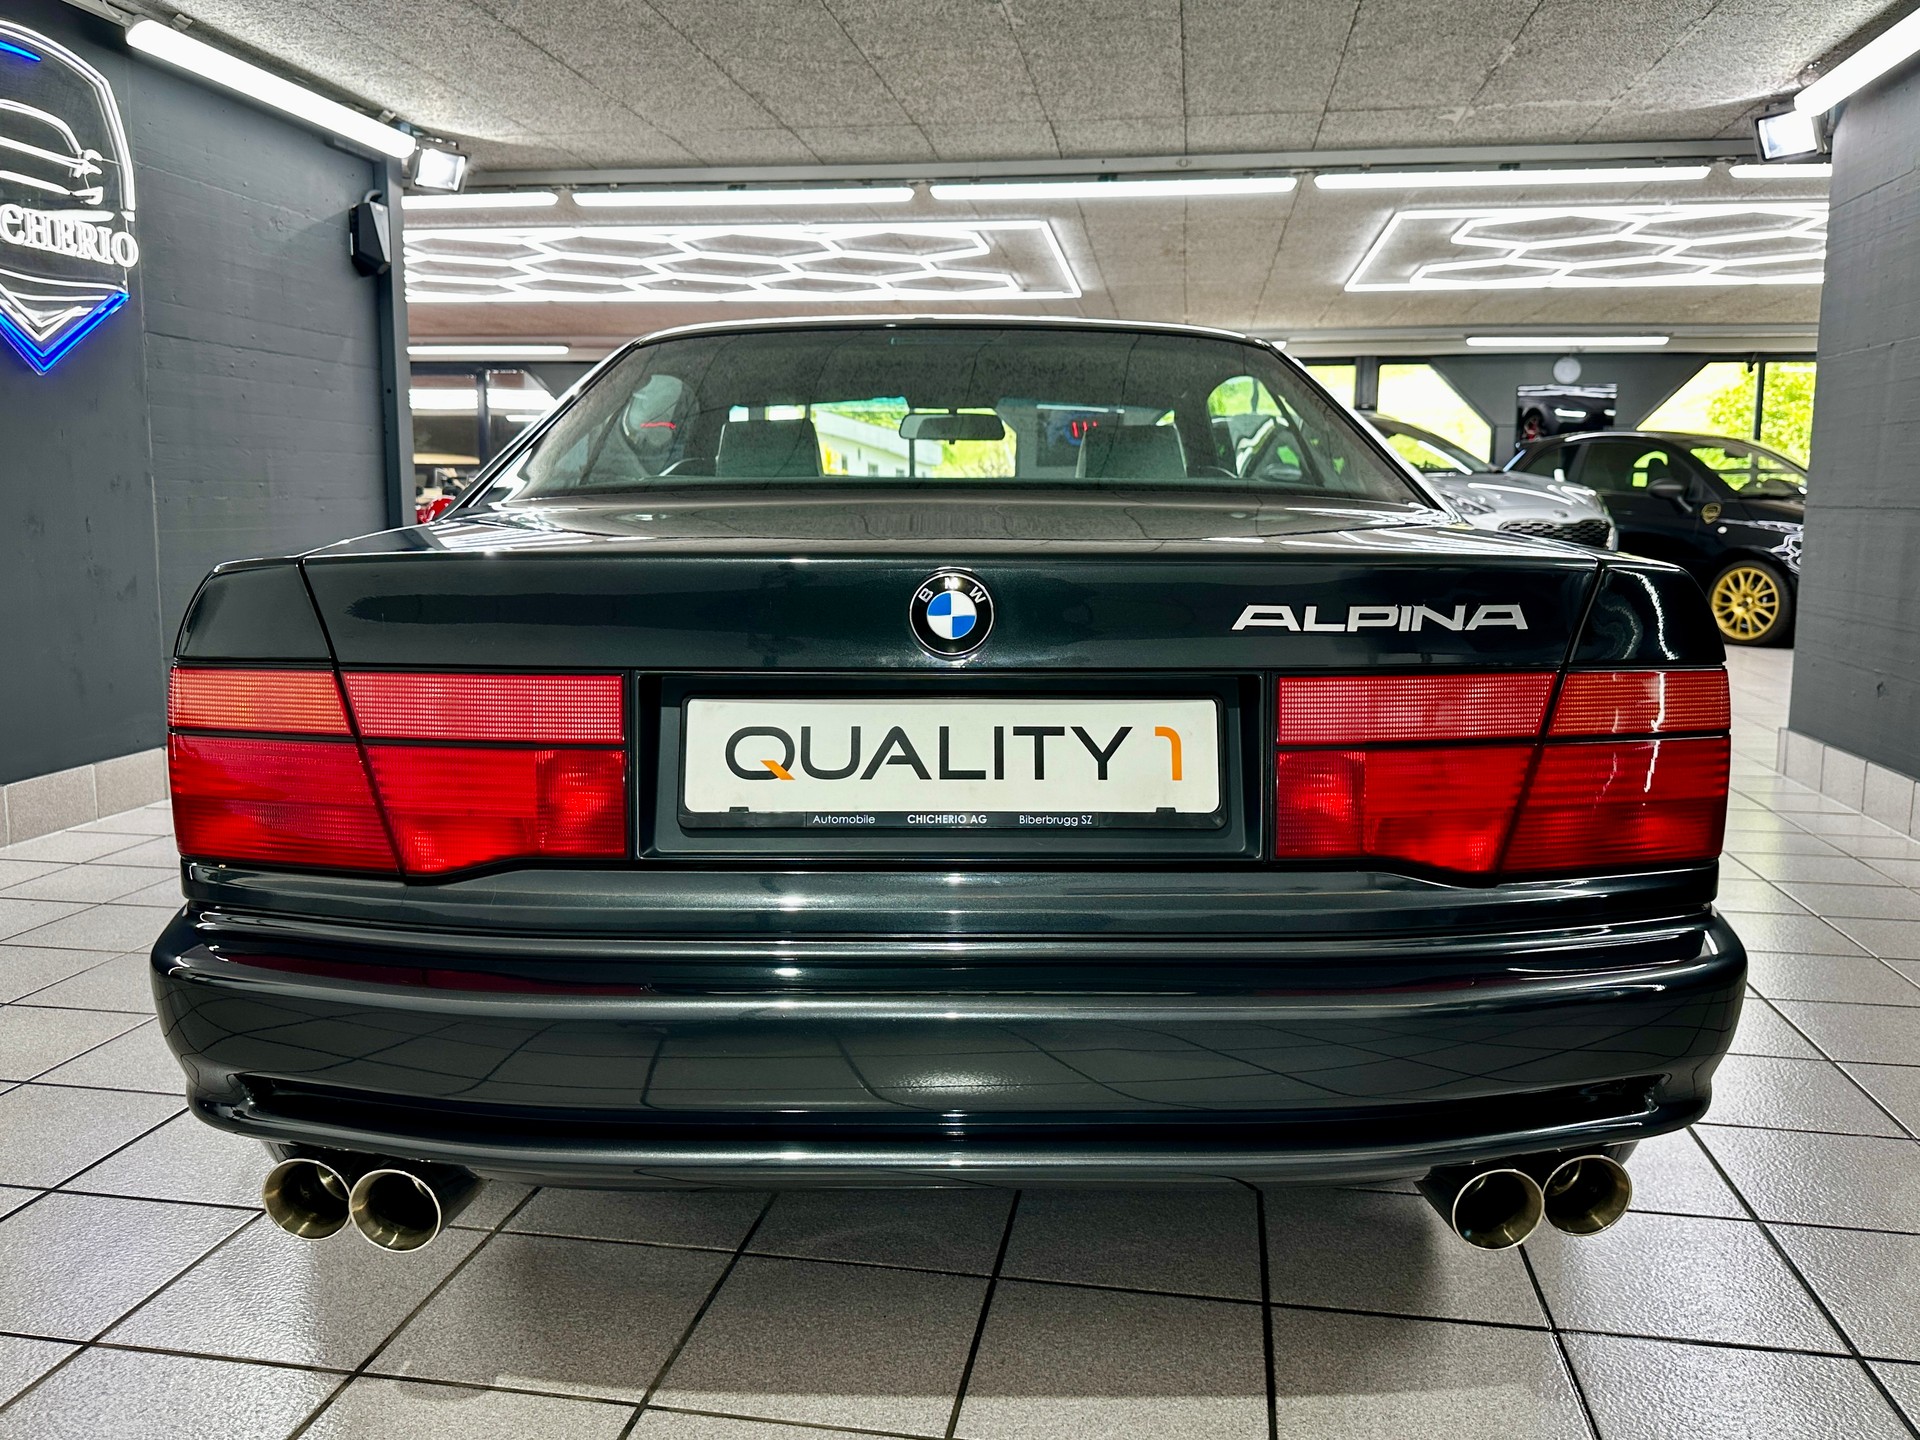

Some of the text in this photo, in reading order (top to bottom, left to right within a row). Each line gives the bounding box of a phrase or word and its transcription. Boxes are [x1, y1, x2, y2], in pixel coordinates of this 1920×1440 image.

[918, 577, 987, 603] BMW
[1231, 604, 1529, 632] ALPINA
[725, 725, 1183, 781] QUALITY 1
[812, 814, 1093, 827] Automobile CHICHERIO AG Biberbrugg SZ
